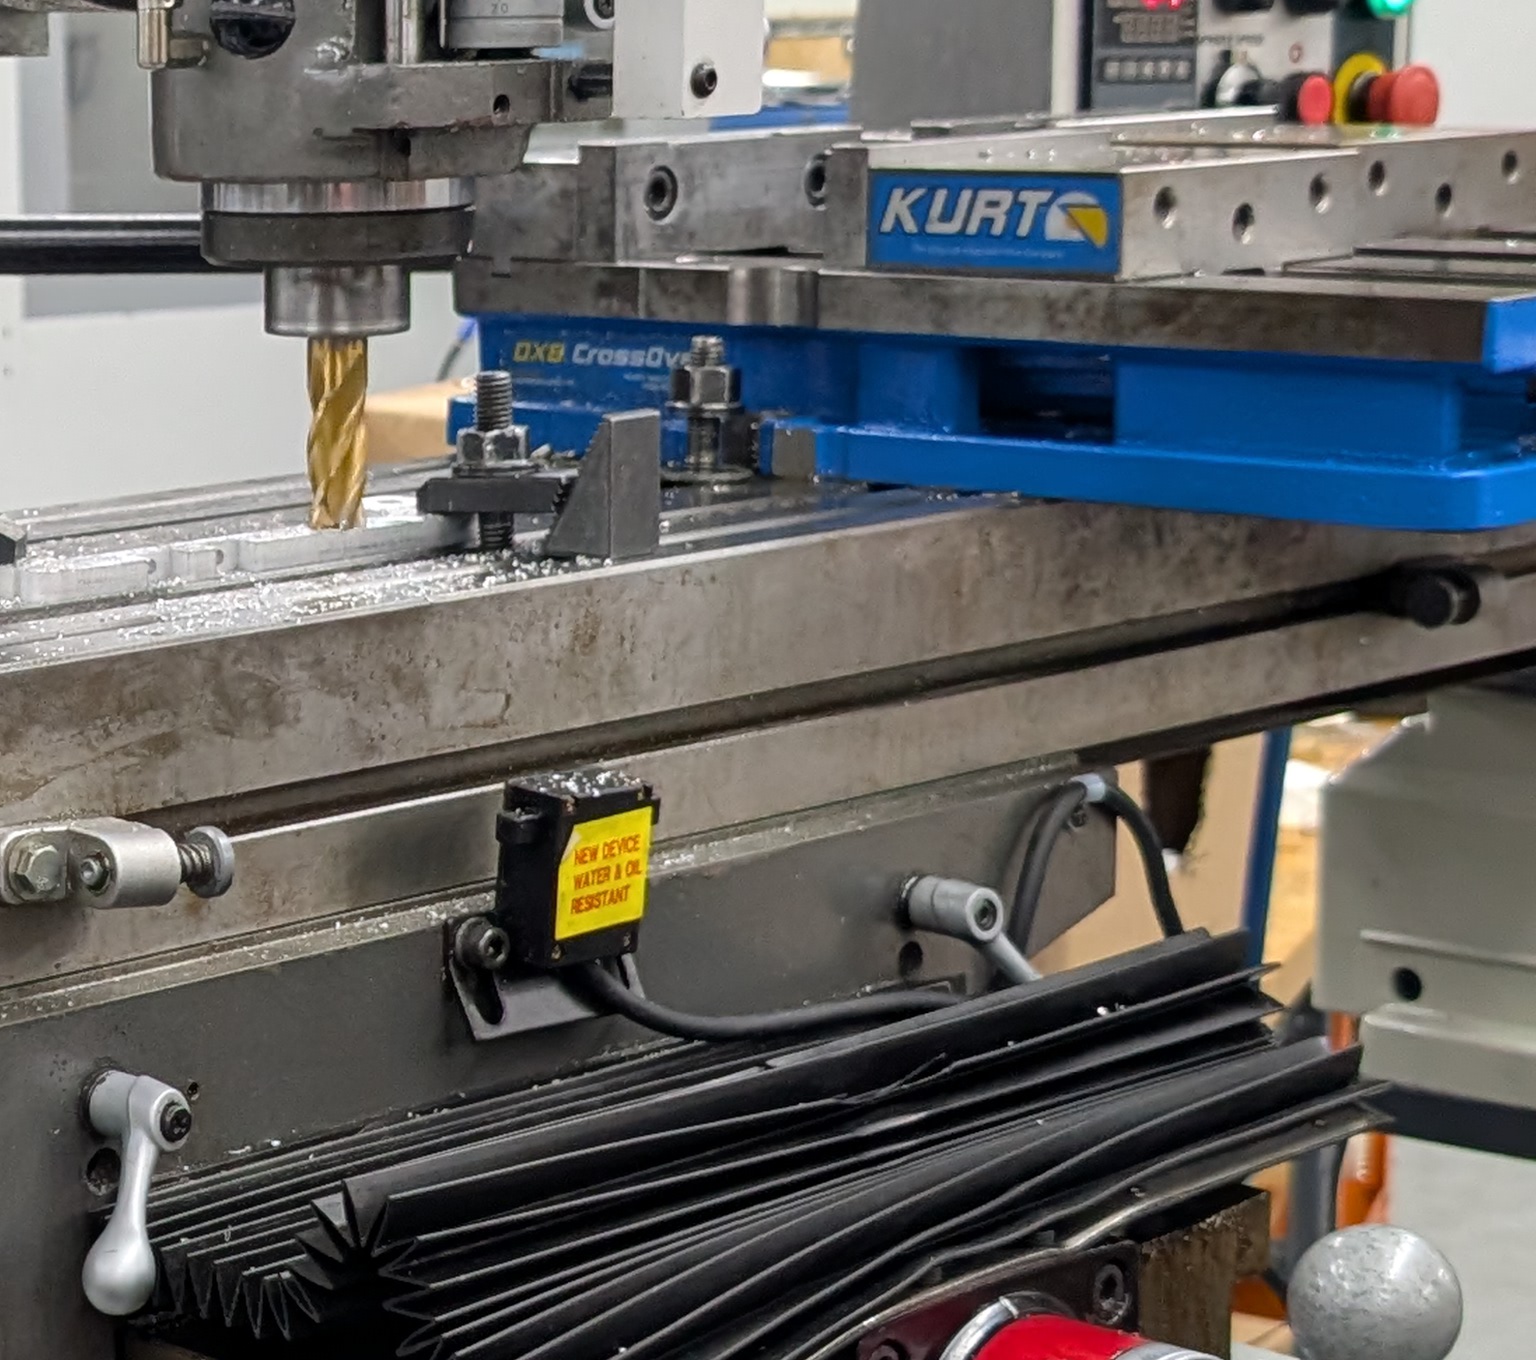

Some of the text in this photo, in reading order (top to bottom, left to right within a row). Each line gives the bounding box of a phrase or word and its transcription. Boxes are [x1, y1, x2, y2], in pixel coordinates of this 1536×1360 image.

[879, 187, 1054, 238] KURT
[572, 343, 692, 369] CrossOve
[574, 833, 641, 866] NEW DEVICE
[573, 865, 611, 891] WATER
[570, 883, 631, 915] RESISTANT
